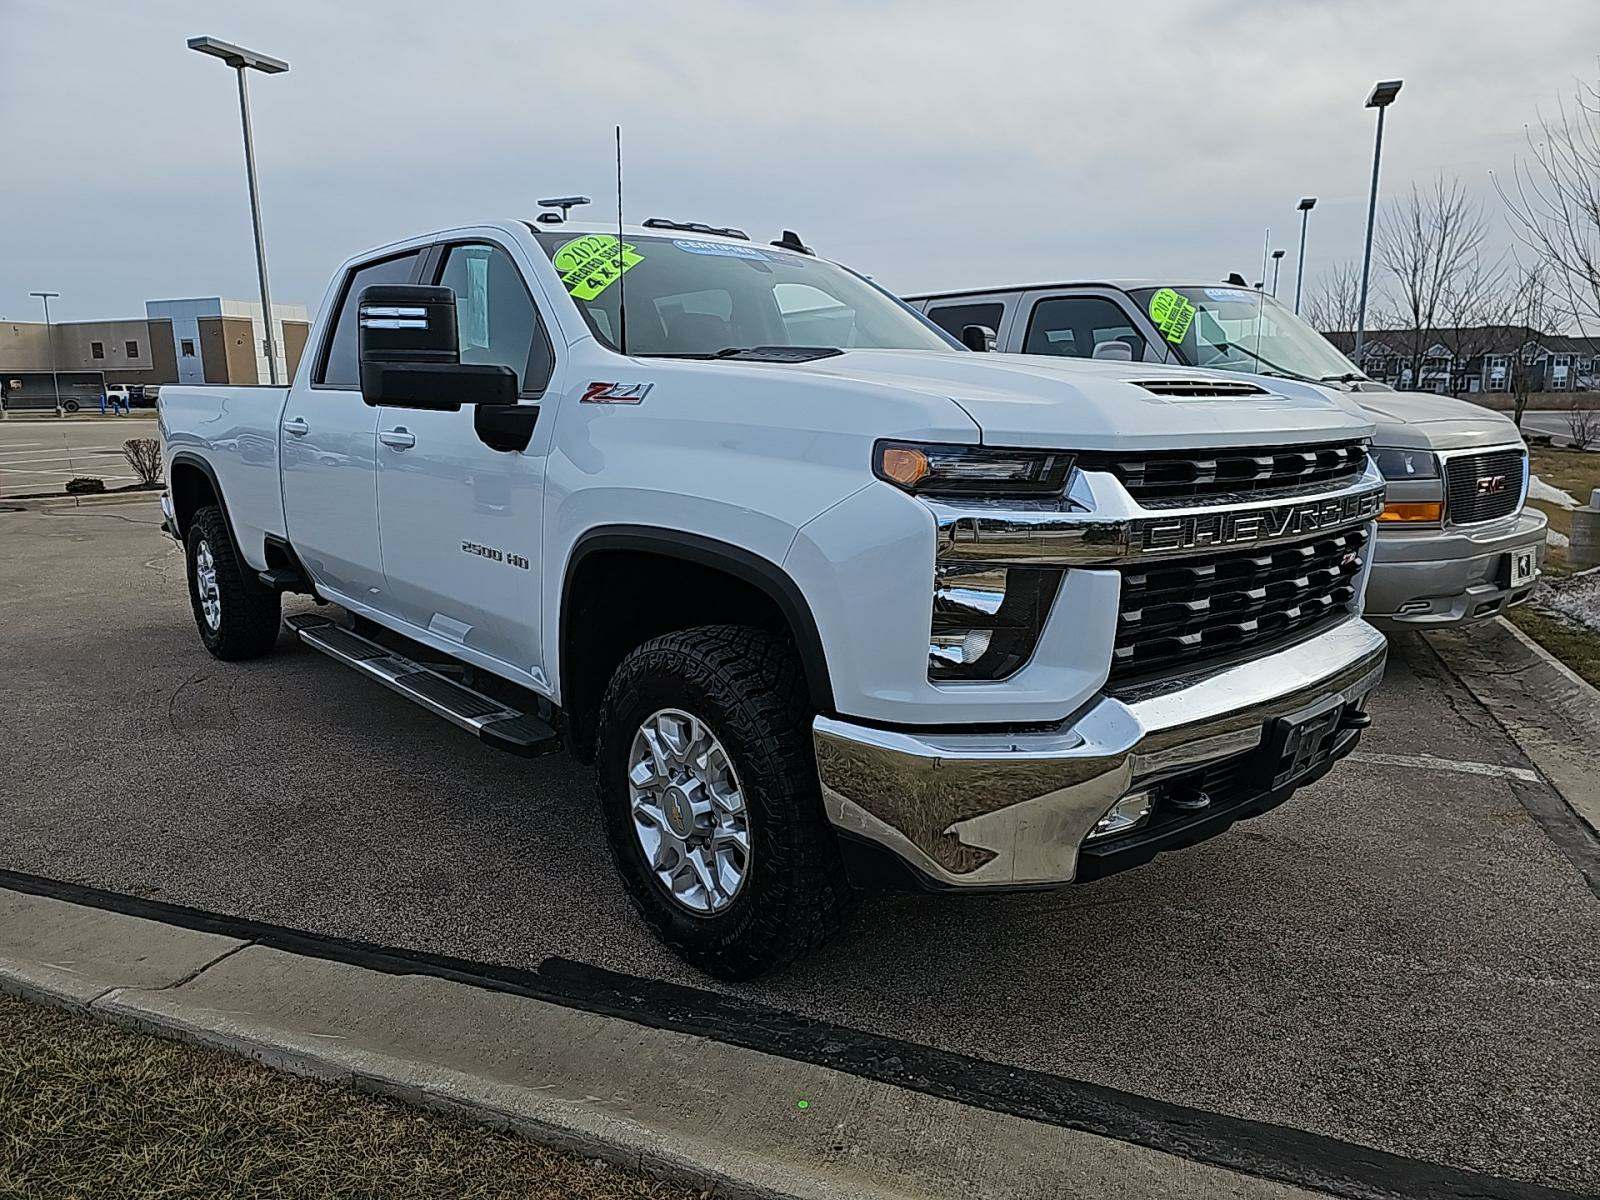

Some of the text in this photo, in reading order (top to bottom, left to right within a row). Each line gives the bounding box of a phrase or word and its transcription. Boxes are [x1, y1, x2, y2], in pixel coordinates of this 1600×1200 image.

[562, 237, 607, 266] 2022
[565, 258, 605, 285] HEATED
[1154, 291, 1174, 317] 2023
[1172, 306, 1193, 339] LUXURY
[580, 382, 654, 405] Z71
[1143, 491, 1385, 552] CHEVROLET
[462, 540, 529, 569] 2500 HD
